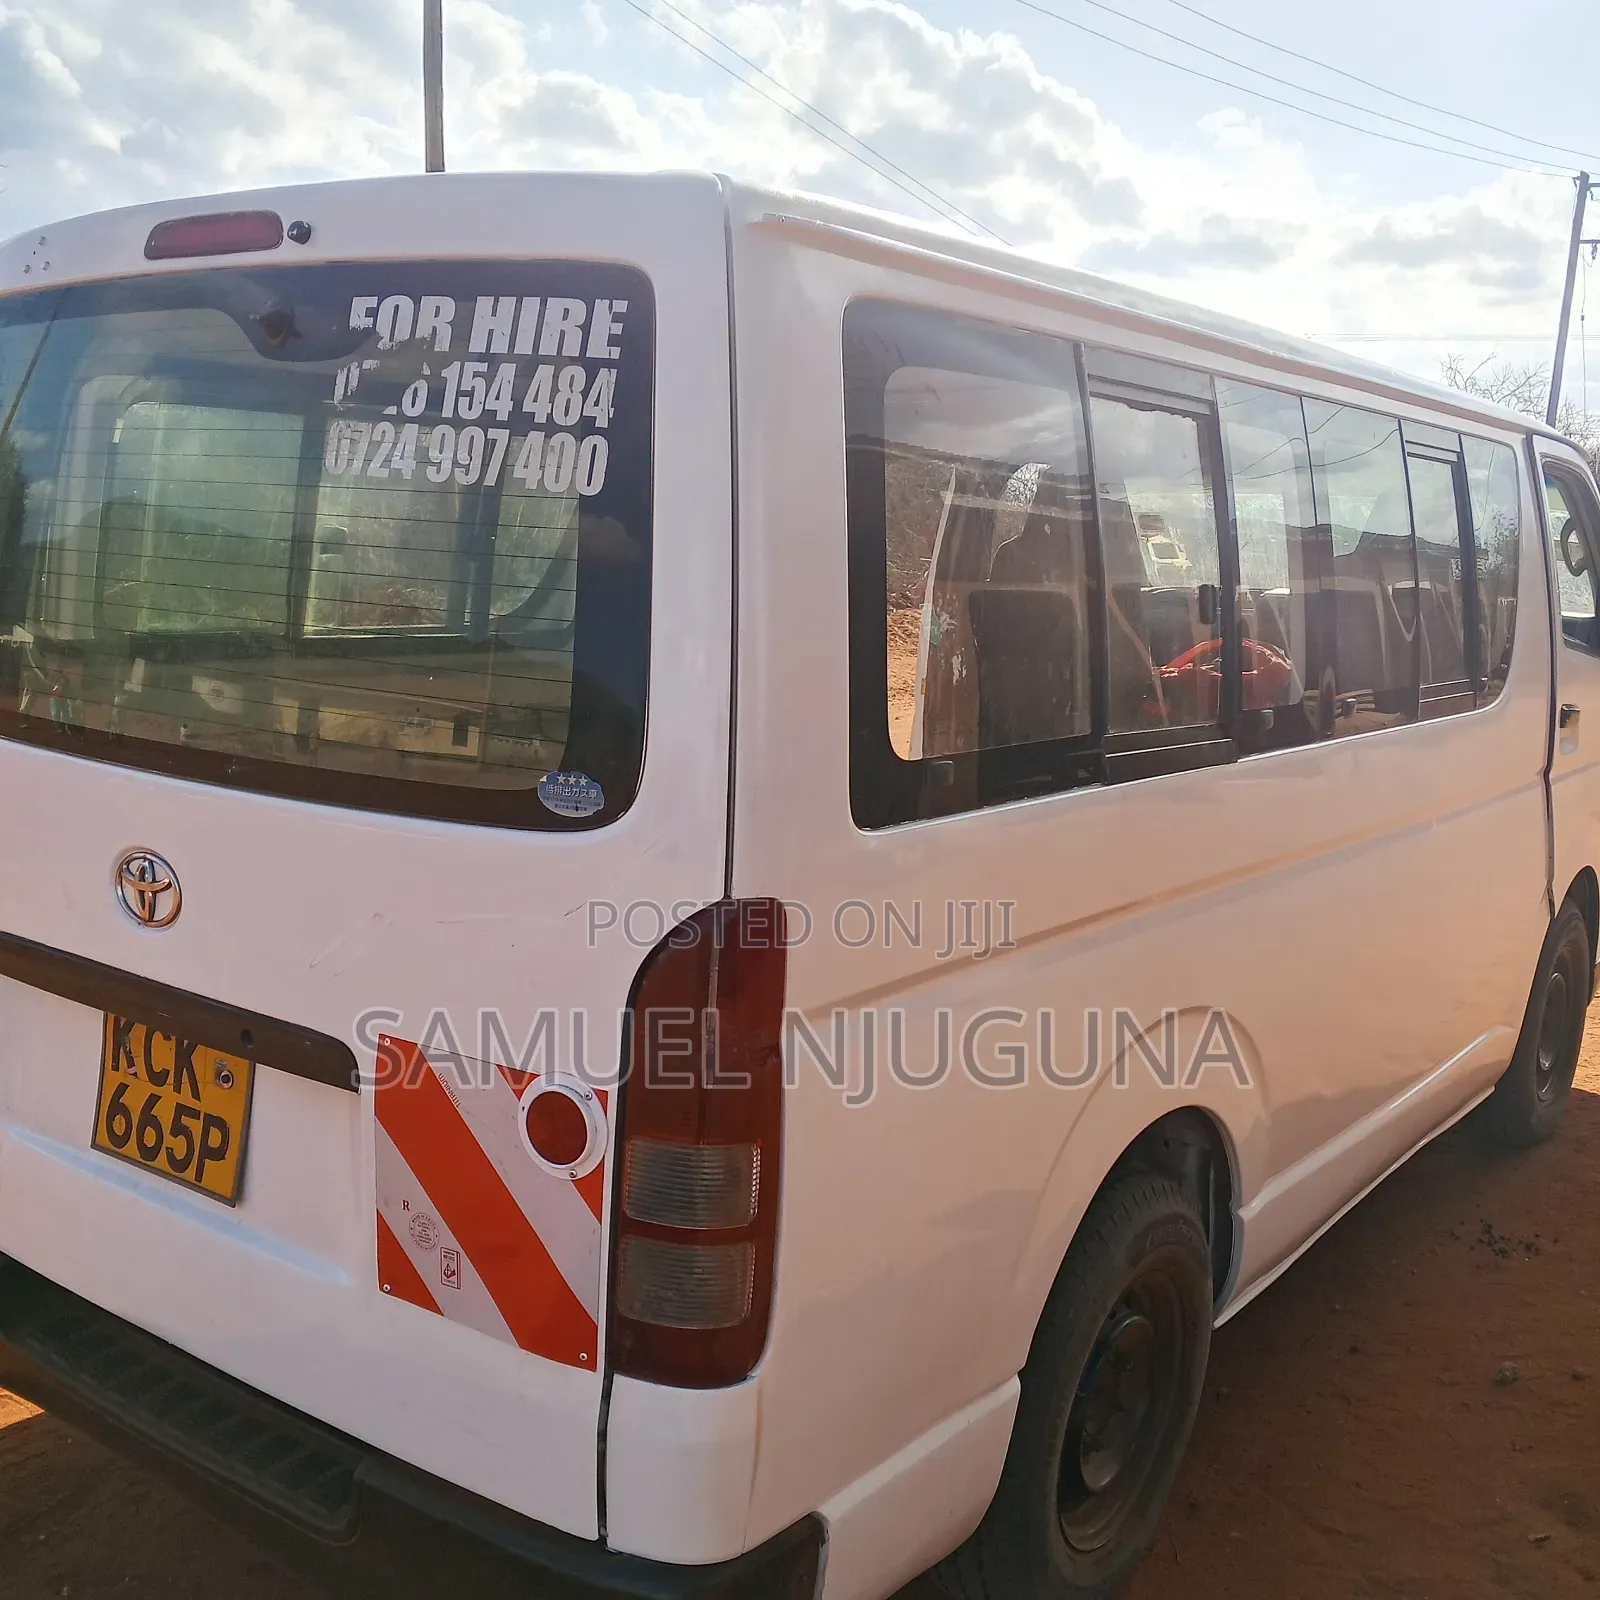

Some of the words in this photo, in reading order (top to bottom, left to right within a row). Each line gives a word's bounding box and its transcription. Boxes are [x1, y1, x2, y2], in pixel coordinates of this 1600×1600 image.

[349, 294, 456, 352] FOR
[468, 296, 629, 360] HIRE
[440, 360, 517, 421] 154
[522, 364, 619, 428] 484
[325, 420, 420, 480] 0724
[426, 424, 510, 487] 997
[513, 431, 609, 497] 400
[111, 1014, 201, 1102] KCK
[106, 1082, 230, 1183] 665P
[402, 1200, 410, 1211] R
